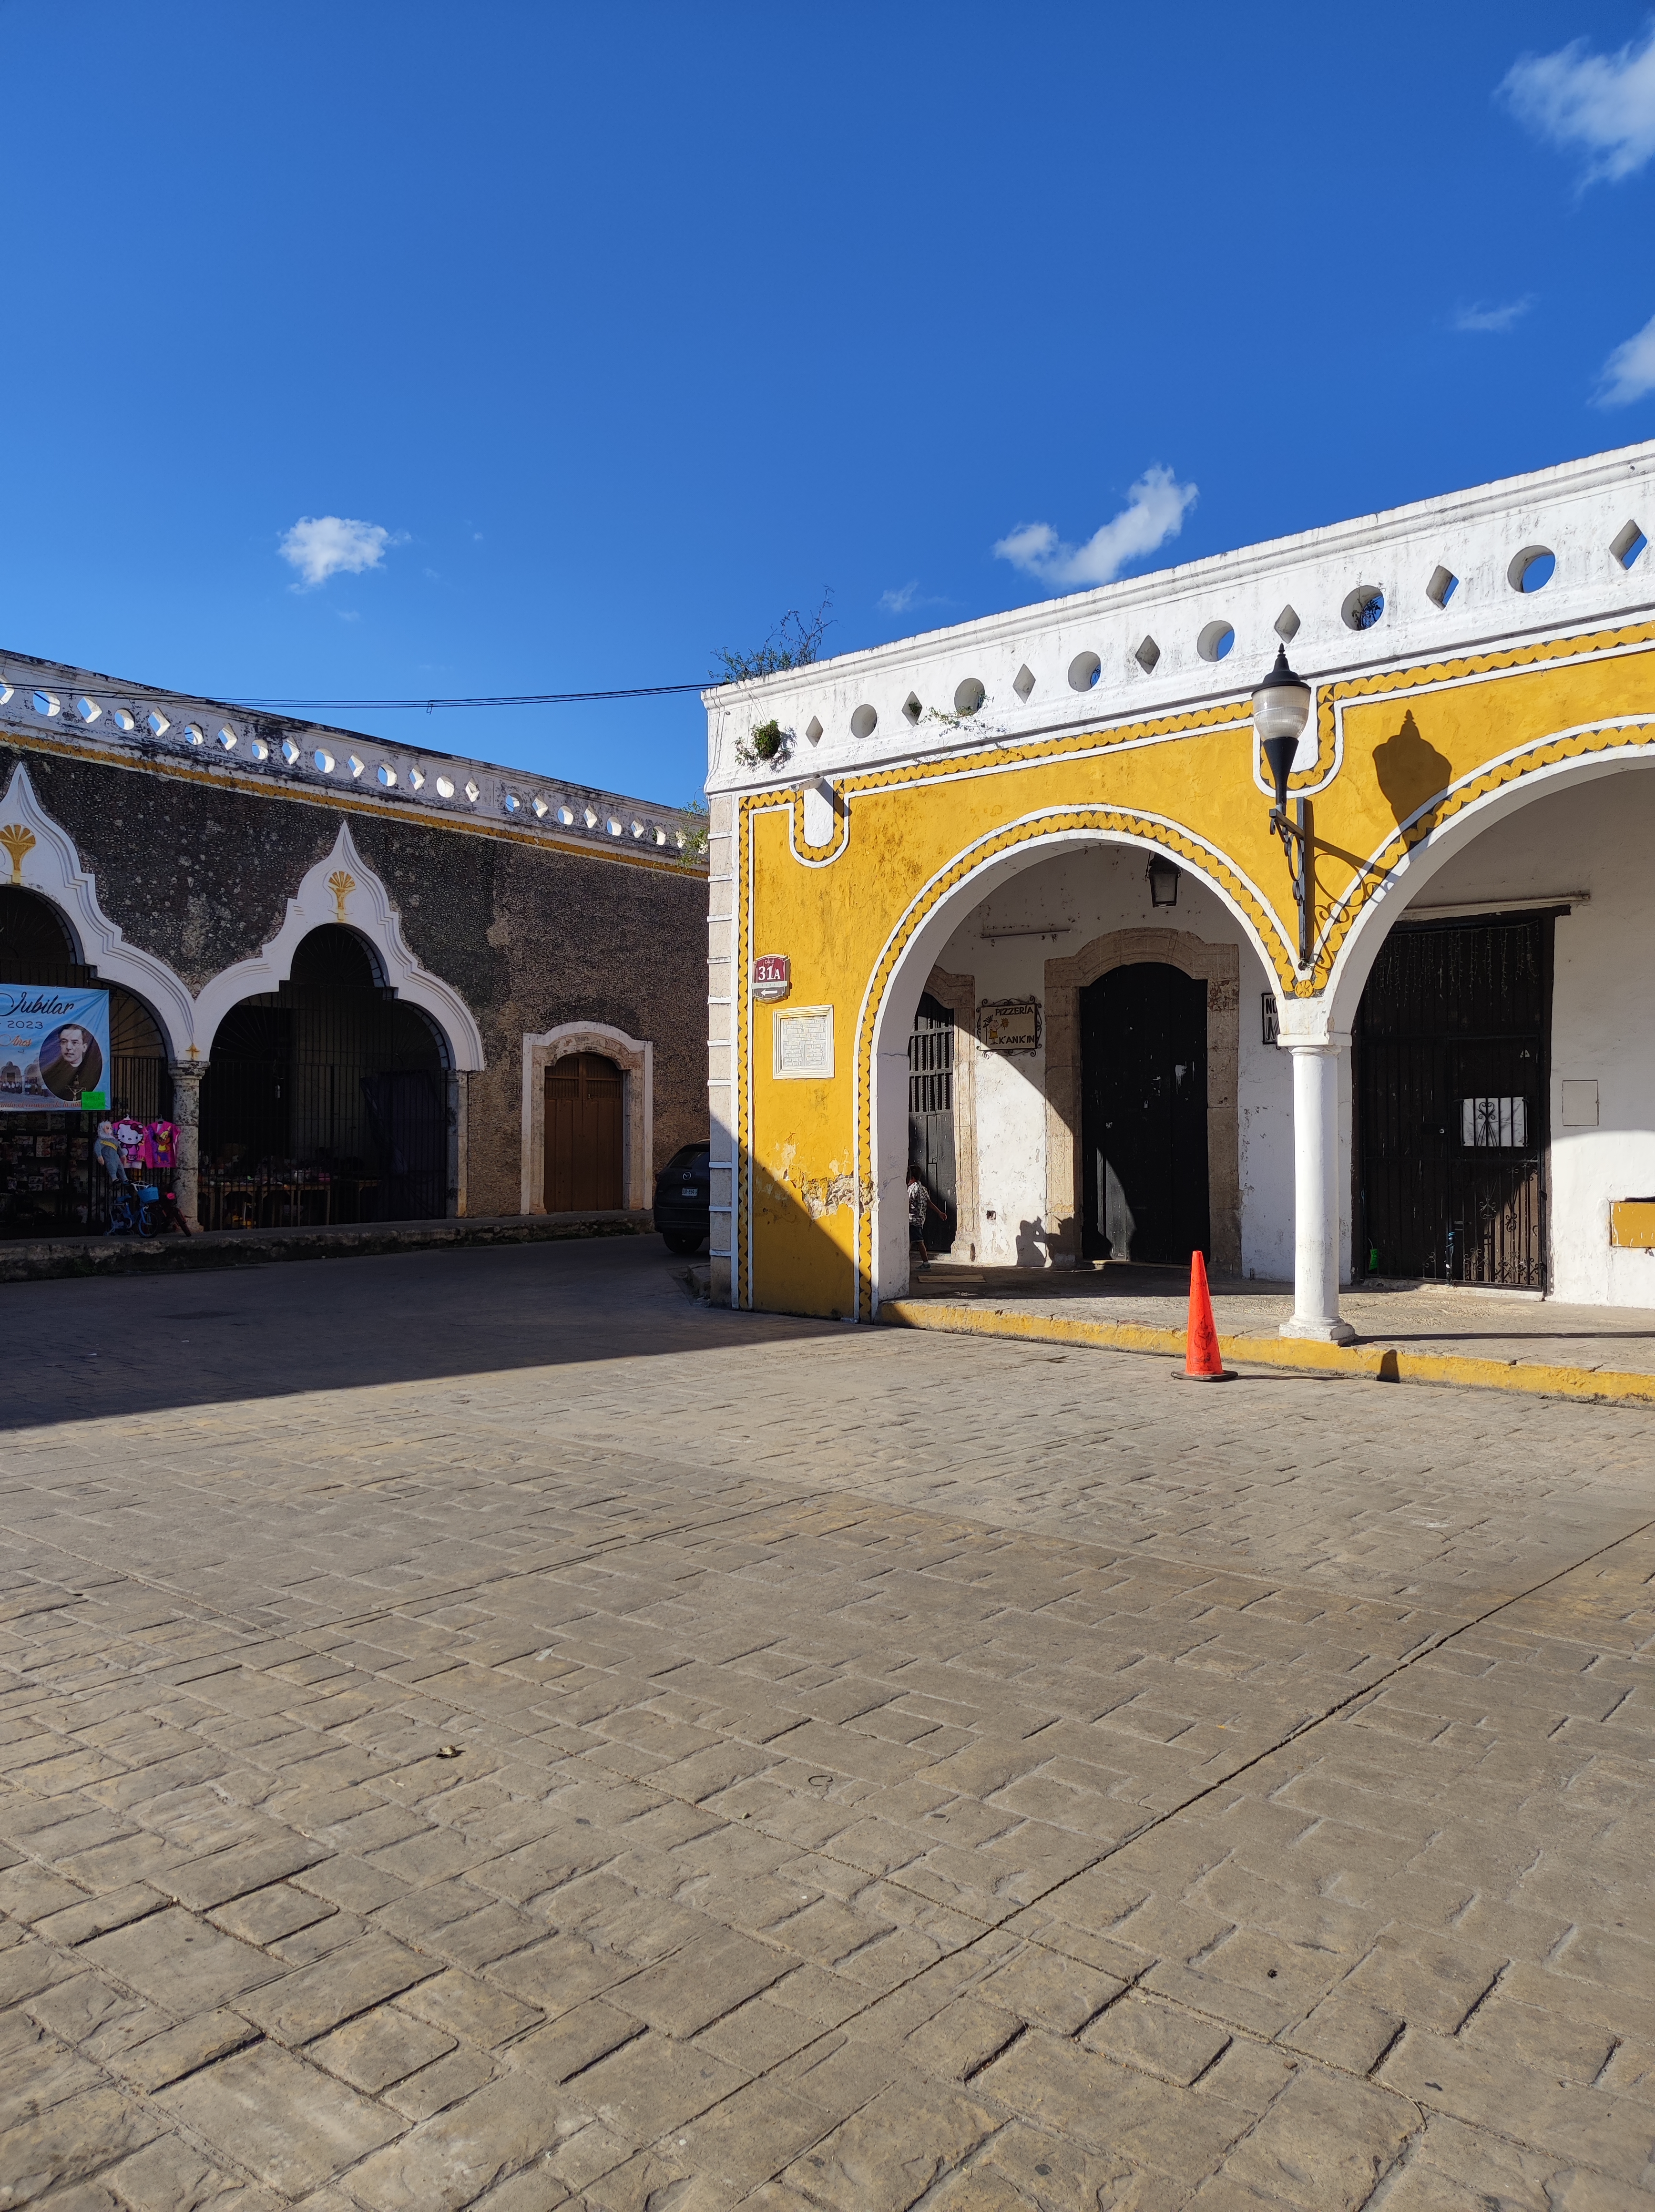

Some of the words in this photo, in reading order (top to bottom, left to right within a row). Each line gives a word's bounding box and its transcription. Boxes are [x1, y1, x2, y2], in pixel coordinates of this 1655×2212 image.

[758, 965, 780, 981] 31A
[0, 991, 74, 1017] Jubilar
[995, 1005, 1034, 1016] PIZZERÍA
[7, 1020, 43, 1029] 2023
